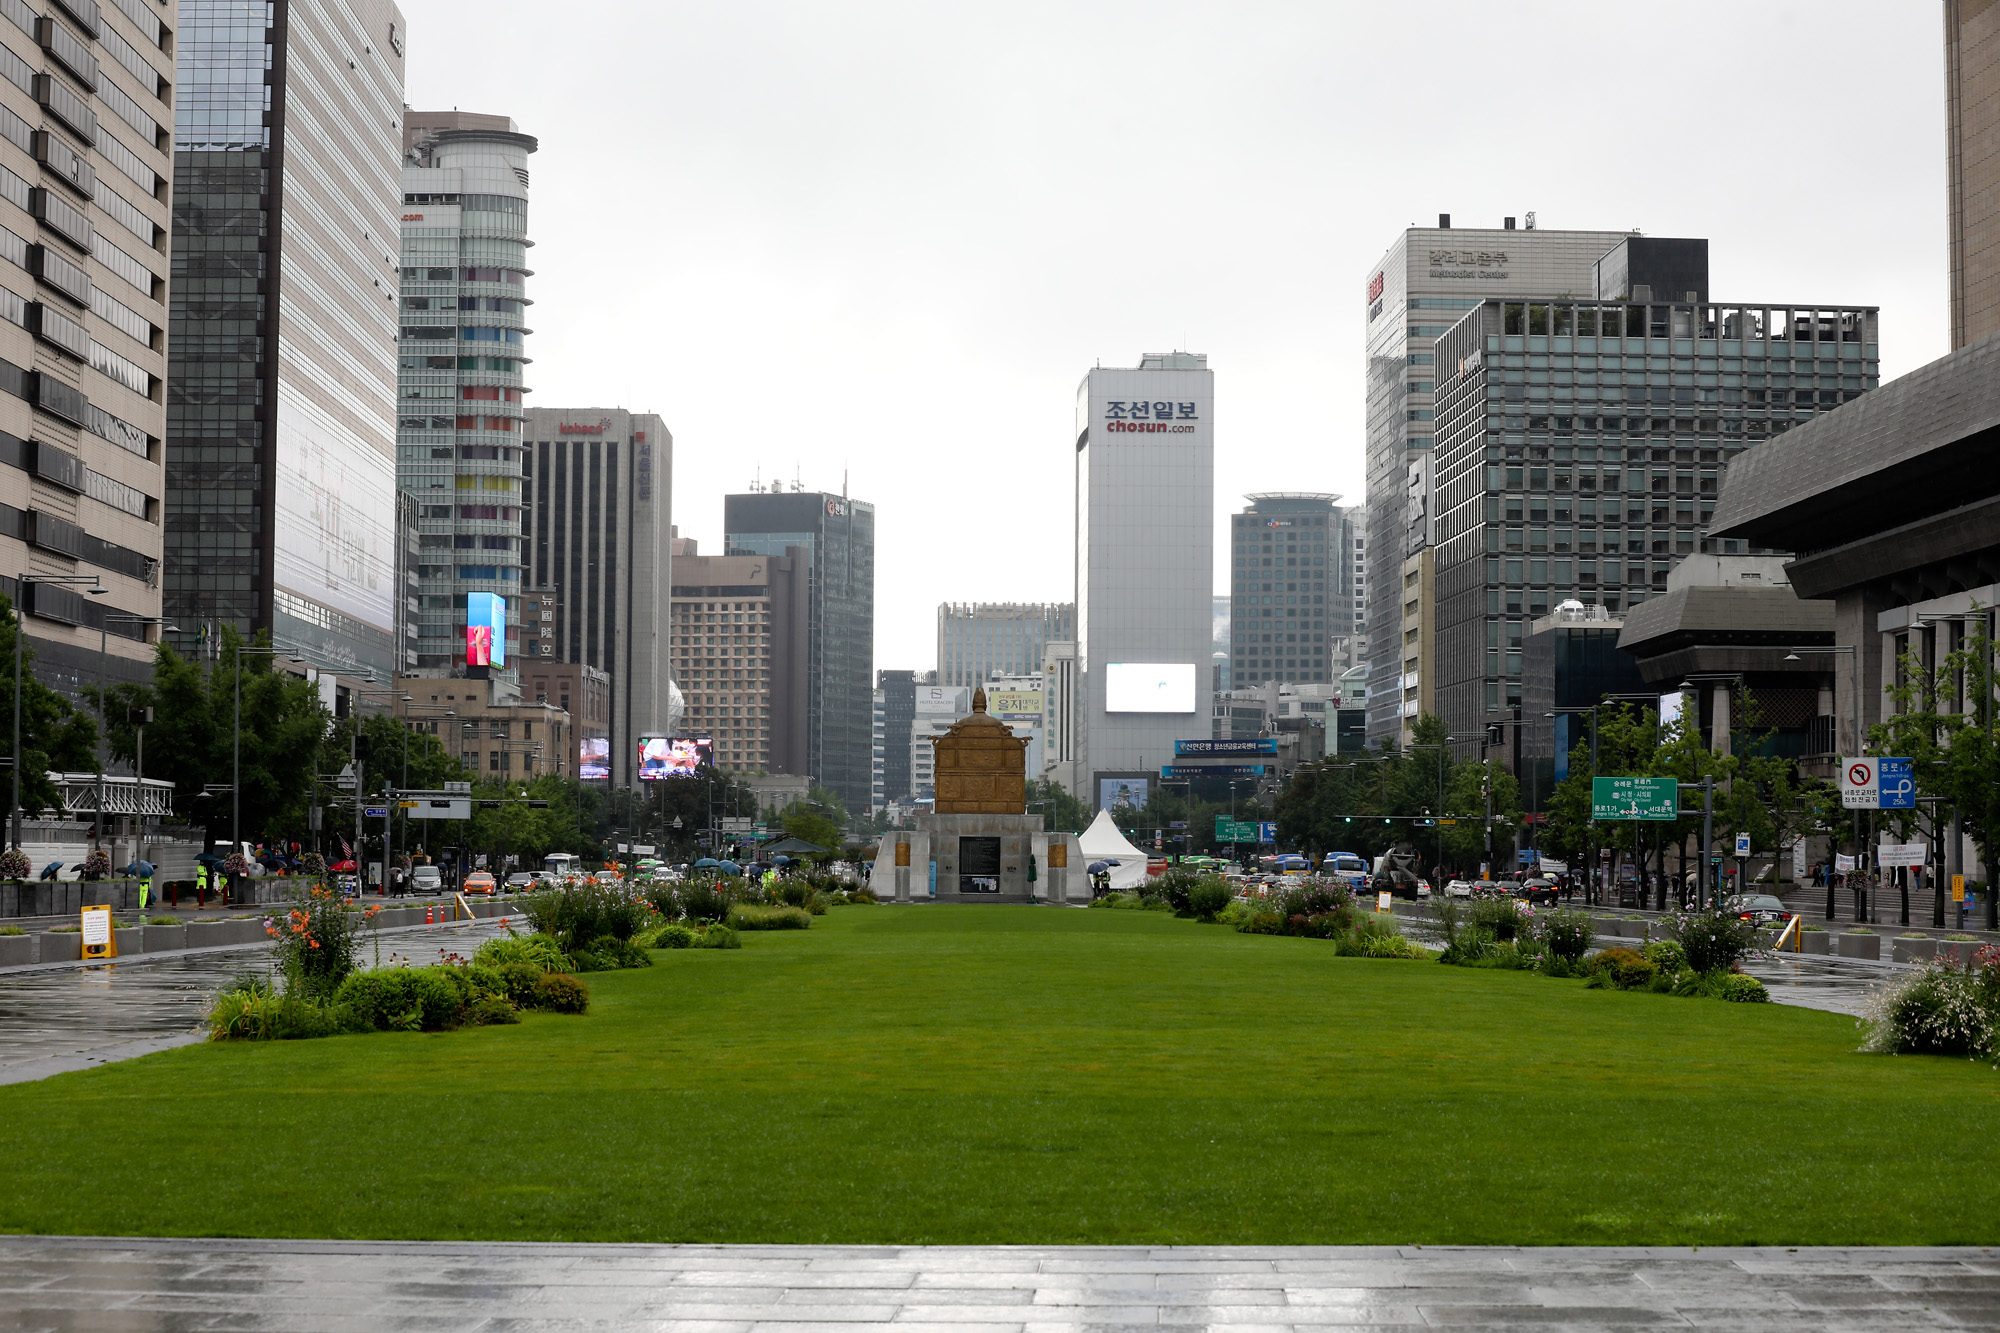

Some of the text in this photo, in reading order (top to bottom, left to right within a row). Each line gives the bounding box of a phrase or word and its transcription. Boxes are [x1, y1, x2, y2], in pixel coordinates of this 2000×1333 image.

[1429, 249, 1509, 267] 감리교본부
[1429, 268, 1509, 279] Methodist Center
[1104, 400, 1199, 420] 조선일보
[560, 421, 604, 434] kobaco
[1106, 420, 1195, 434] chosun.com
[540, 595, 553, 664] 뉴國際호
[998, 699, 1022, 711] 을지
[1186, 742, 1212, 751] 신한은행
[1613, 780, 1632, 788] 숭례문
